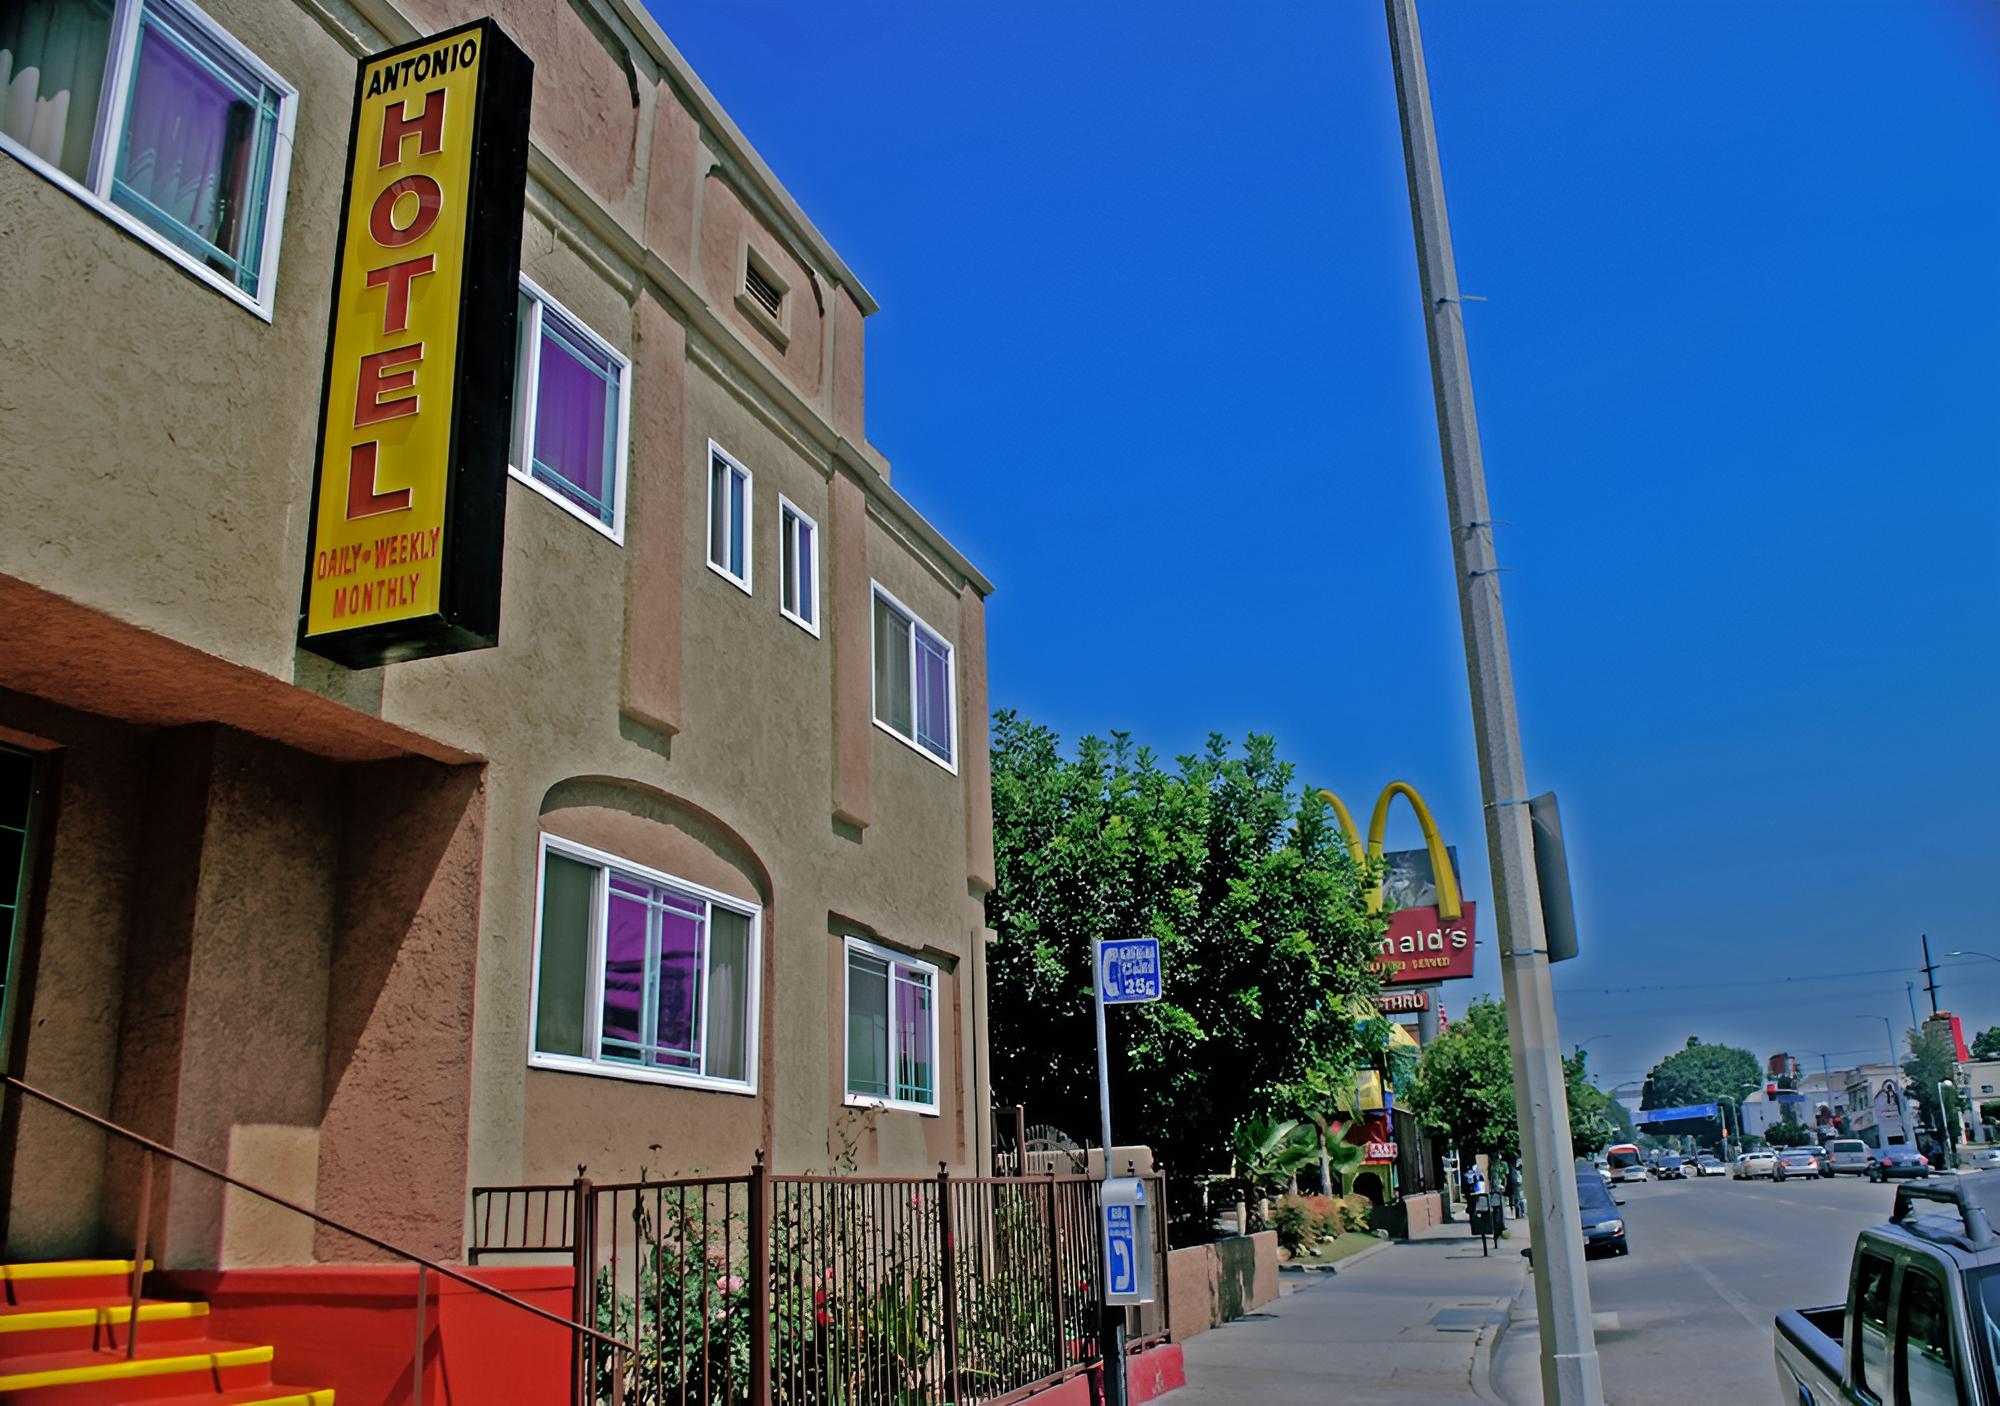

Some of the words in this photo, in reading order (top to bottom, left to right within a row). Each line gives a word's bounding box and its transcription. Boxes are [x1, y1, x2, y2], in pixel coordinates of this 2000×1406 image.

[366, 38, 477, 99] ANTONIO
[345, 87, 448, 522] HOTEL
[317, 542, 362, 580] DAILY
[374, 526, 441, 571] WEEKLY
[332, 572, 420, 619] MONTHLY
[1379, 928, 1467, 954] nald's
